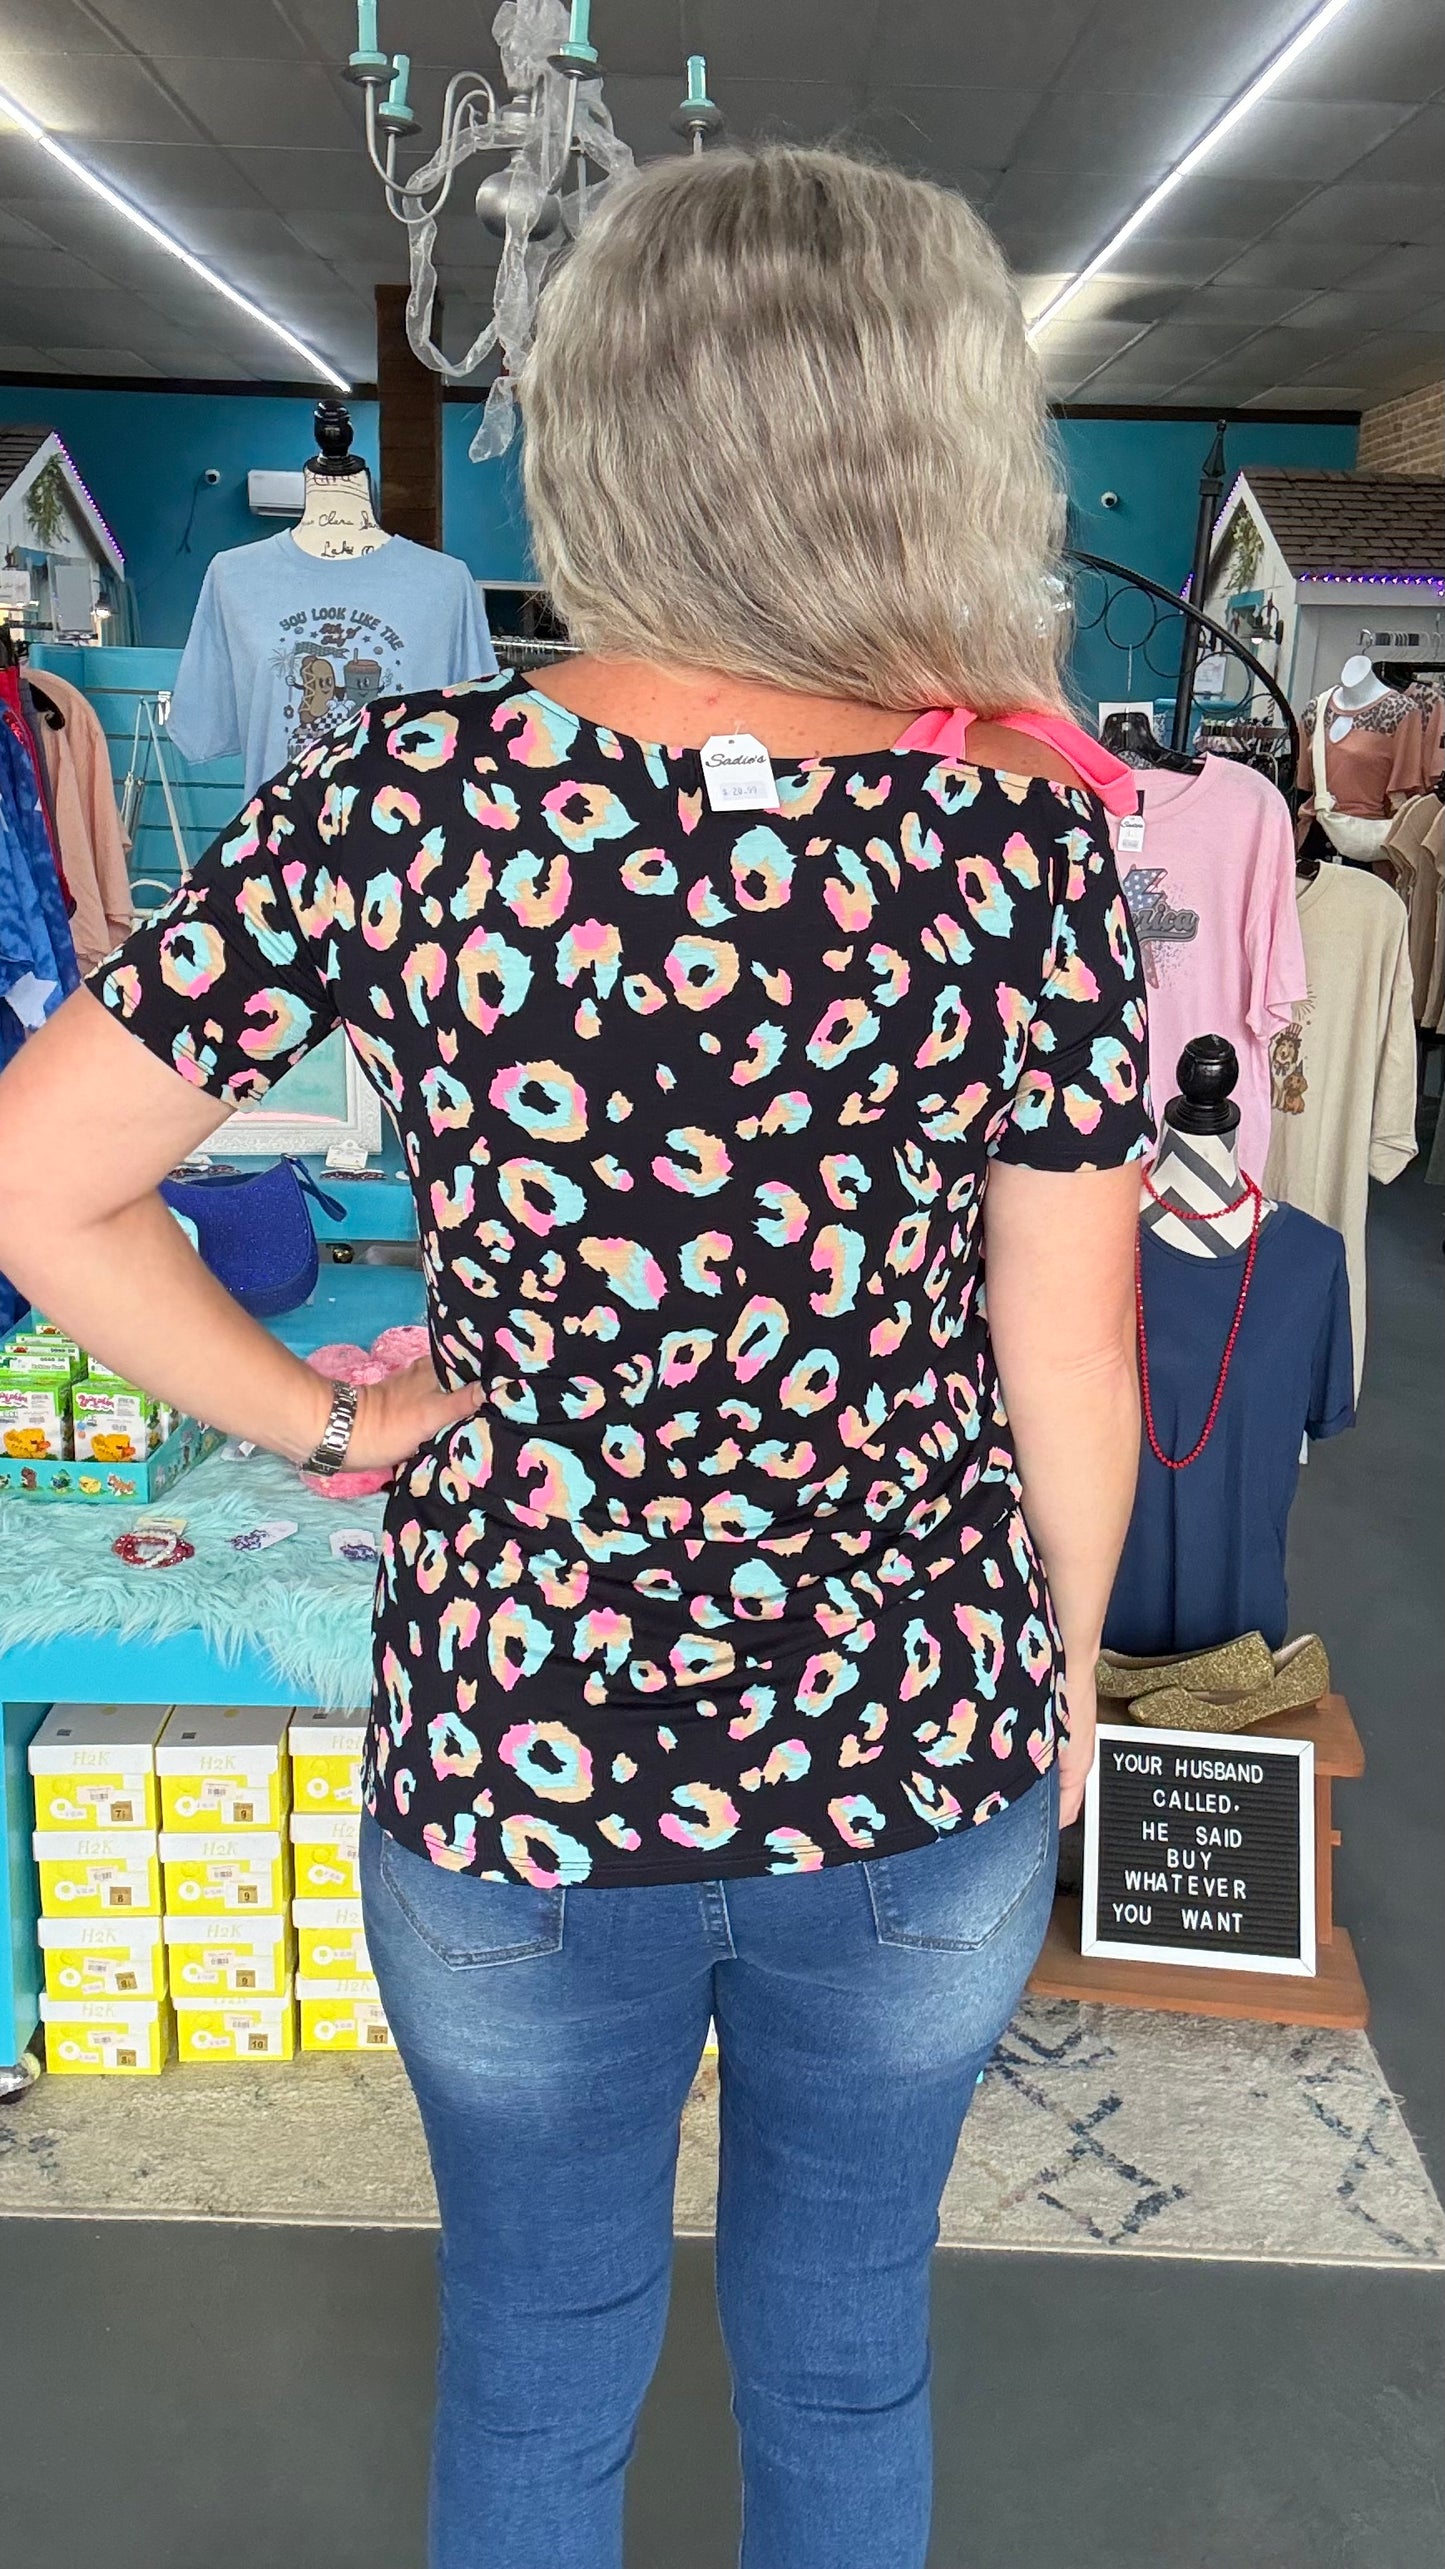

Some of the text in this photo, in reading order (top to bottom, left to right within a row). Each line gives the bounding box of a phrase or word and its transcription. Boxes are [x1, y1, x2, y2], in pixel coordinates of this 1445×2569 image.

[279, 607, 405, 651] YOU LOOK LIKE THE
[705, 753, 766, 768] Sadie's
[73, 1751, 111, 1766] H2K
[200, 1755, 236, 1770] H2K
[1112, 1752, 1264, 1784] YOUR HUSBAND
[1152, 1788, 1240, 1814] CALLED.
[332, 1823, 356, 1838] H2
[1142, 1821, 1243, 1849] HE SAID
[78, 1840, 113, 1854] H2K
[203, 1841, 239, 1856] H2K
[1167, 1848, 1212, 1870] BUY
[1124, 1870, 1247, 1900] WHATEVER
[336, 1909, 360, 1924] H2
[1112, 1903, 1243, 1933] YOU WANT
[81, 1927, 117, 1943] H2K
[207, 1924, 243, 1938] H2K
[251, 2040, 264, 2049] 10
